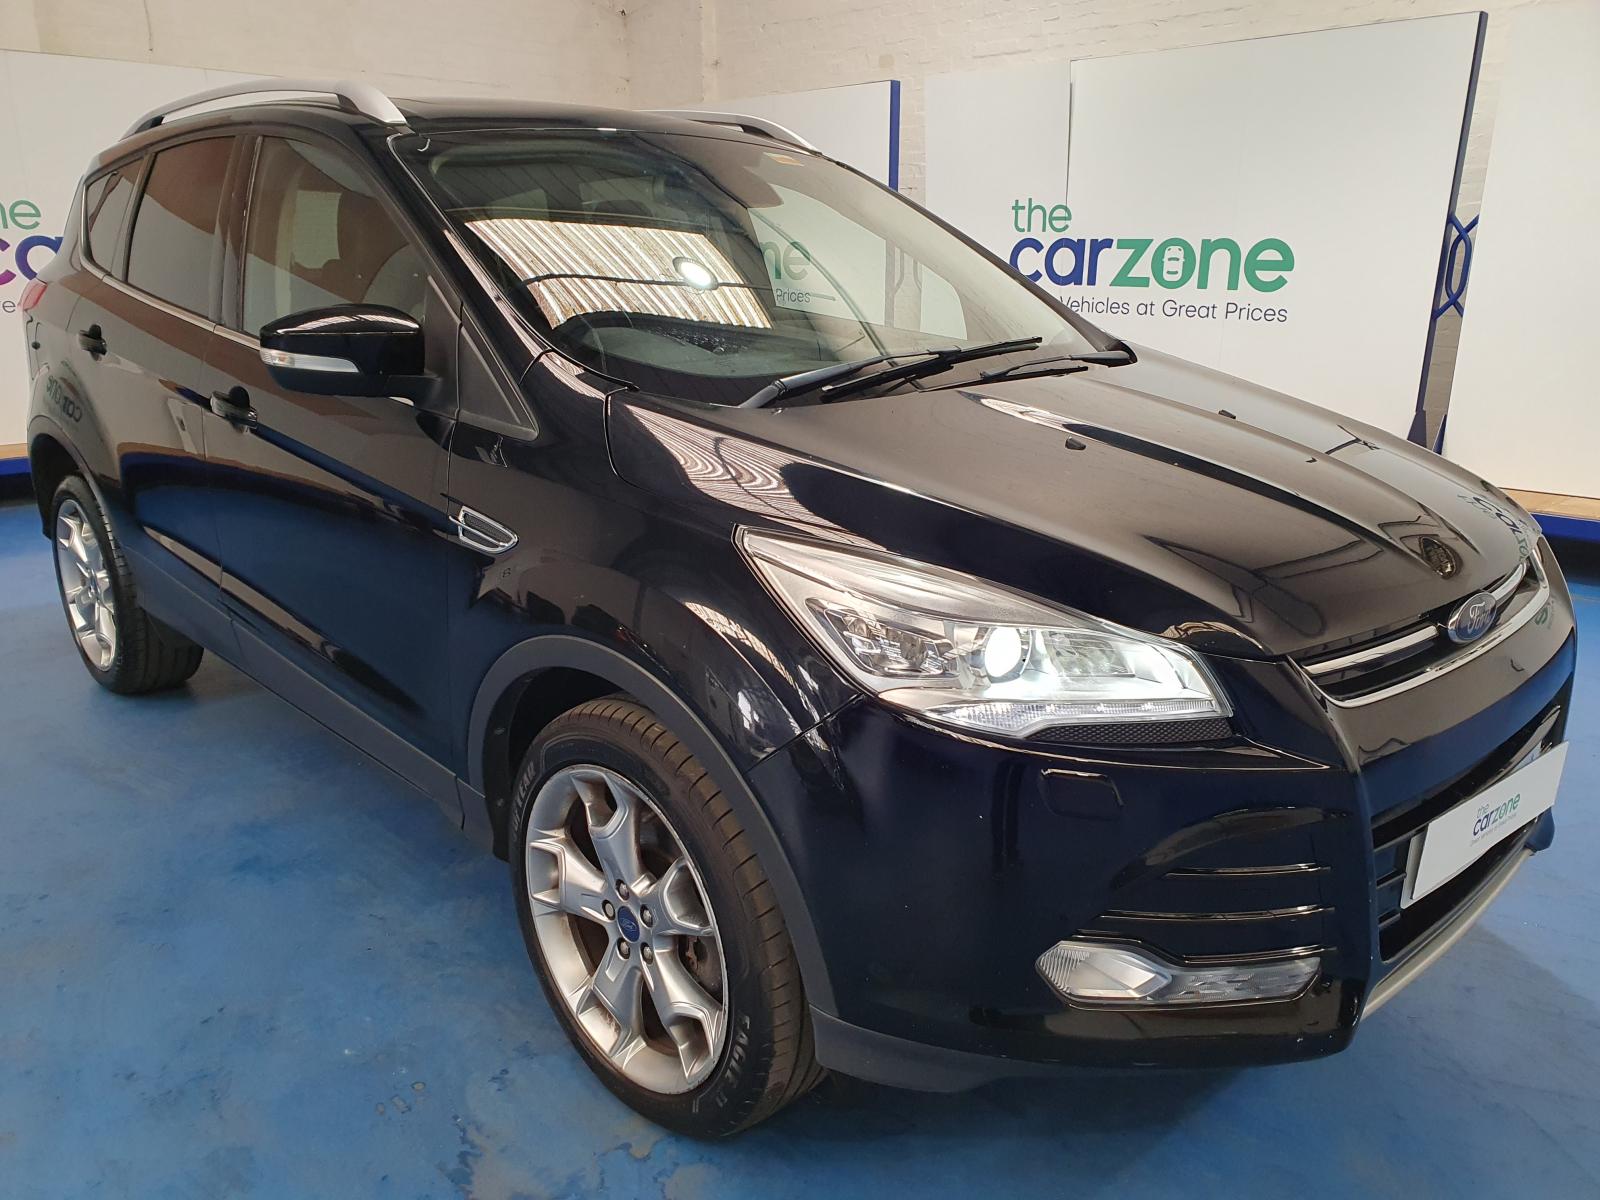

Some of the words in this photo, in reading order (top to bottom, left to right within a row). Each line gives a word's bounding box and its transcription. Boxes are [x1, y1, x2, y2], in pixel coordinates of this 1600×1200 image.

[1012, 198, 1072, 233] the
[1009, 237, 1295, 292] carzone
[776, 288, 811, 303] Prices
[1136, 300, 1155, 316] at
[1162, 299, 1217, 319] Great
[1225, 302, 1288, 322] Prices
[1467, 601, 1492, 634] Ford
[1473, 793, 1521, 837] carzone
